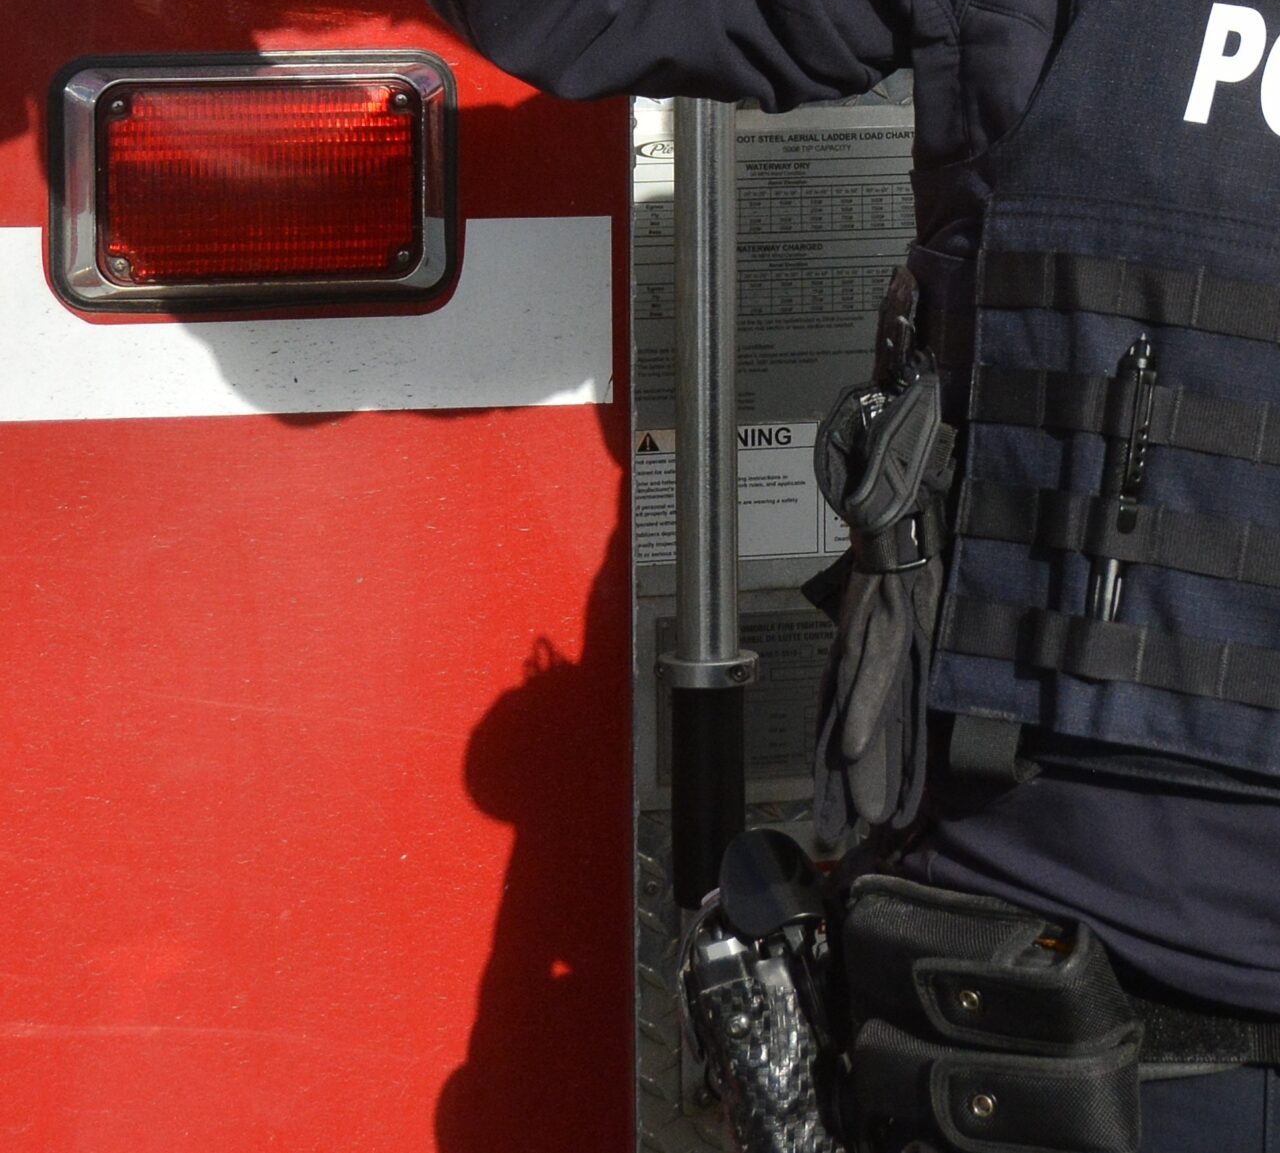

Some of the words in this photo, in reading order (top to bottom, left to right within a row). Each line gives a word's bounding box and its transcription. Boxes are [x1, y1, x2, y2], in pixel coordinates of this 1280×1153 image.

[736, 135, 755, 144] OOT
[757, 134, 784, 143] STEEL
[787, 133, 819, 142] AERIAL
[821, 132, 857, 141] LADDER
[859, 131, 883, 141] LOAD
[885, 130, 915, 140] CHART
[745, 162, 791, 171] WATERWAY
[793, 161, 810, 170] DRY
[782, 242, 823, 252] CHARGED
[738, 426, 792, 447] NING
